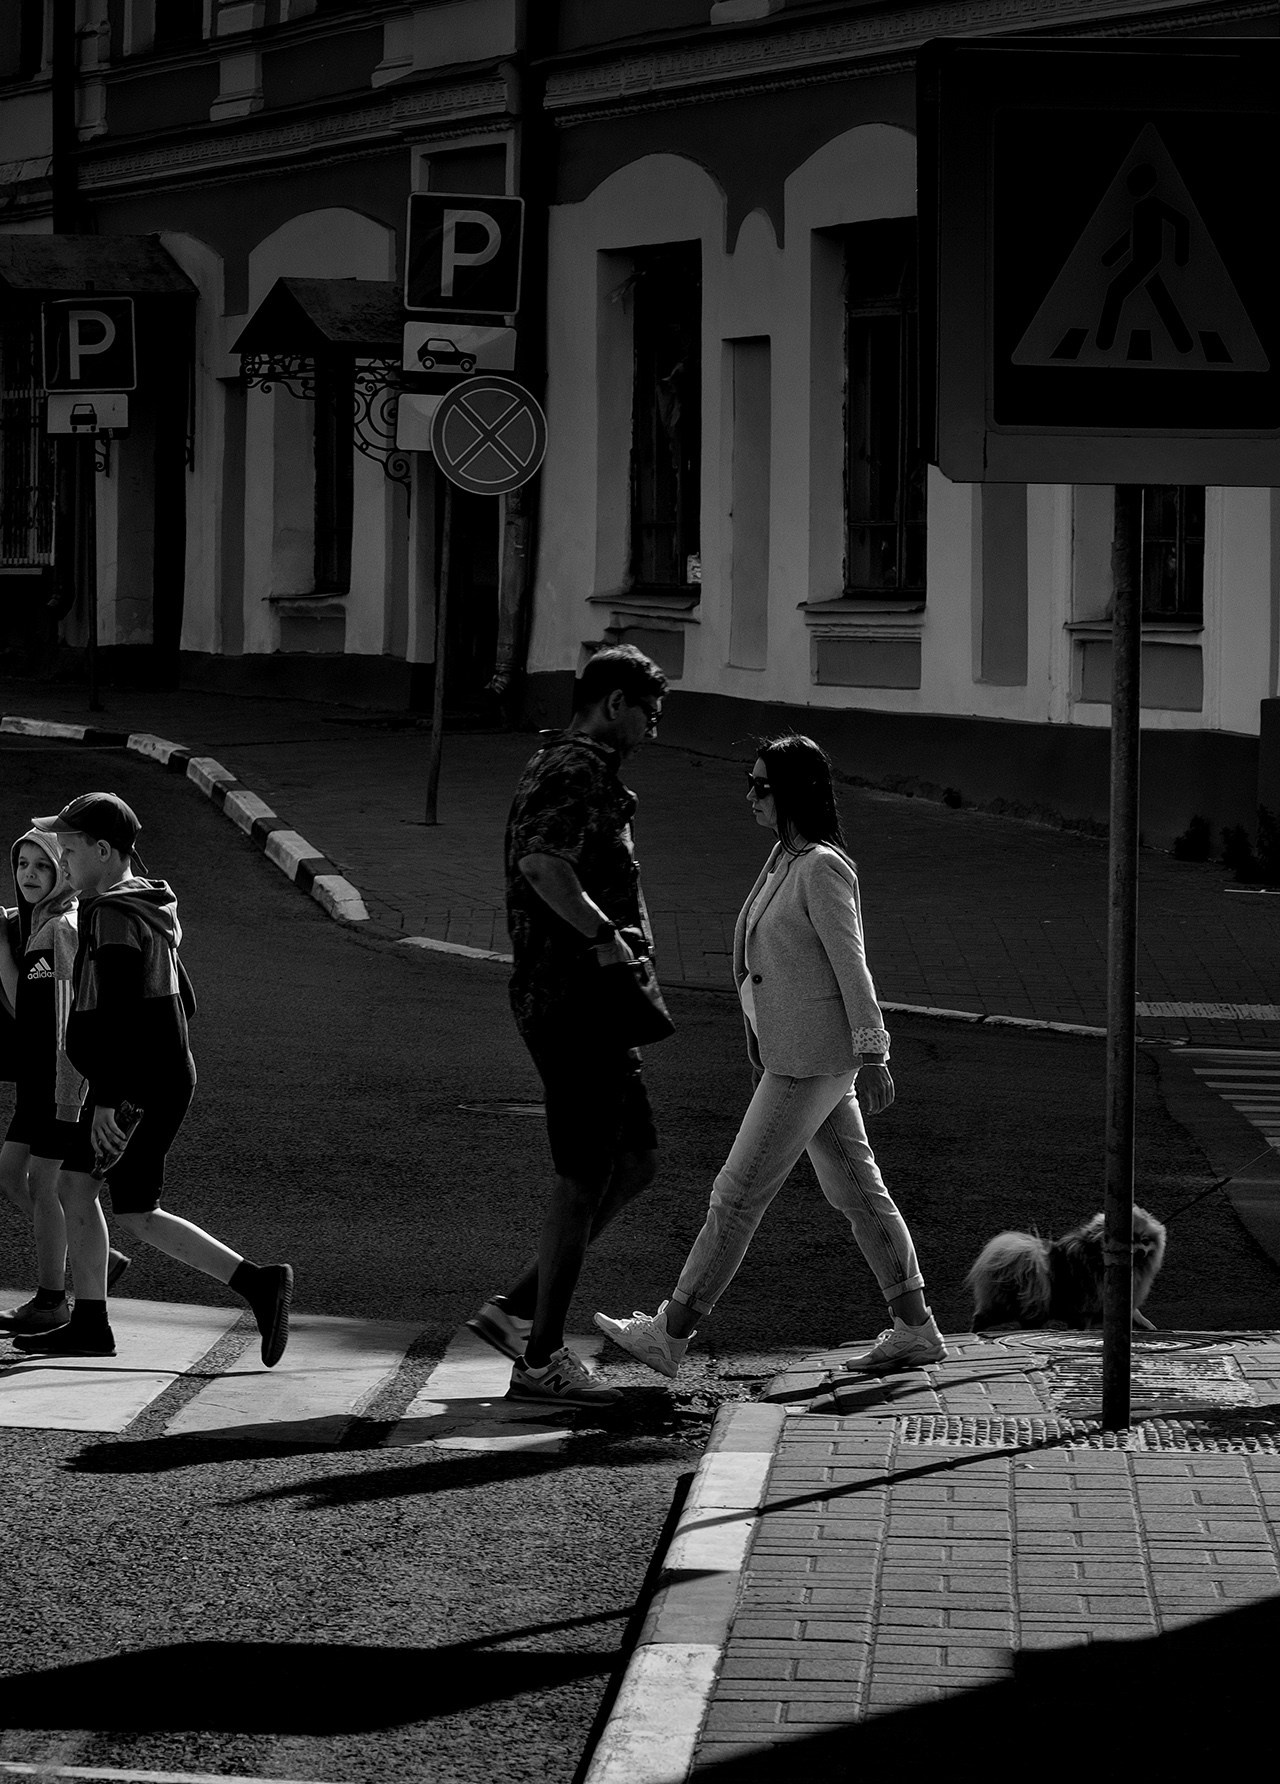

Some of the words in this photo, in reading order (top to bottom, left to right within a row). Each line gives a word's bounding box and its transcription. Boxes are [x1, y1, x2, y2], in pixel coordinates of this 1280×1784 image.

[440, 208, 502, 298] P
[68, 309, 116, 381] P
[542, 1372, 572, 1394] N
